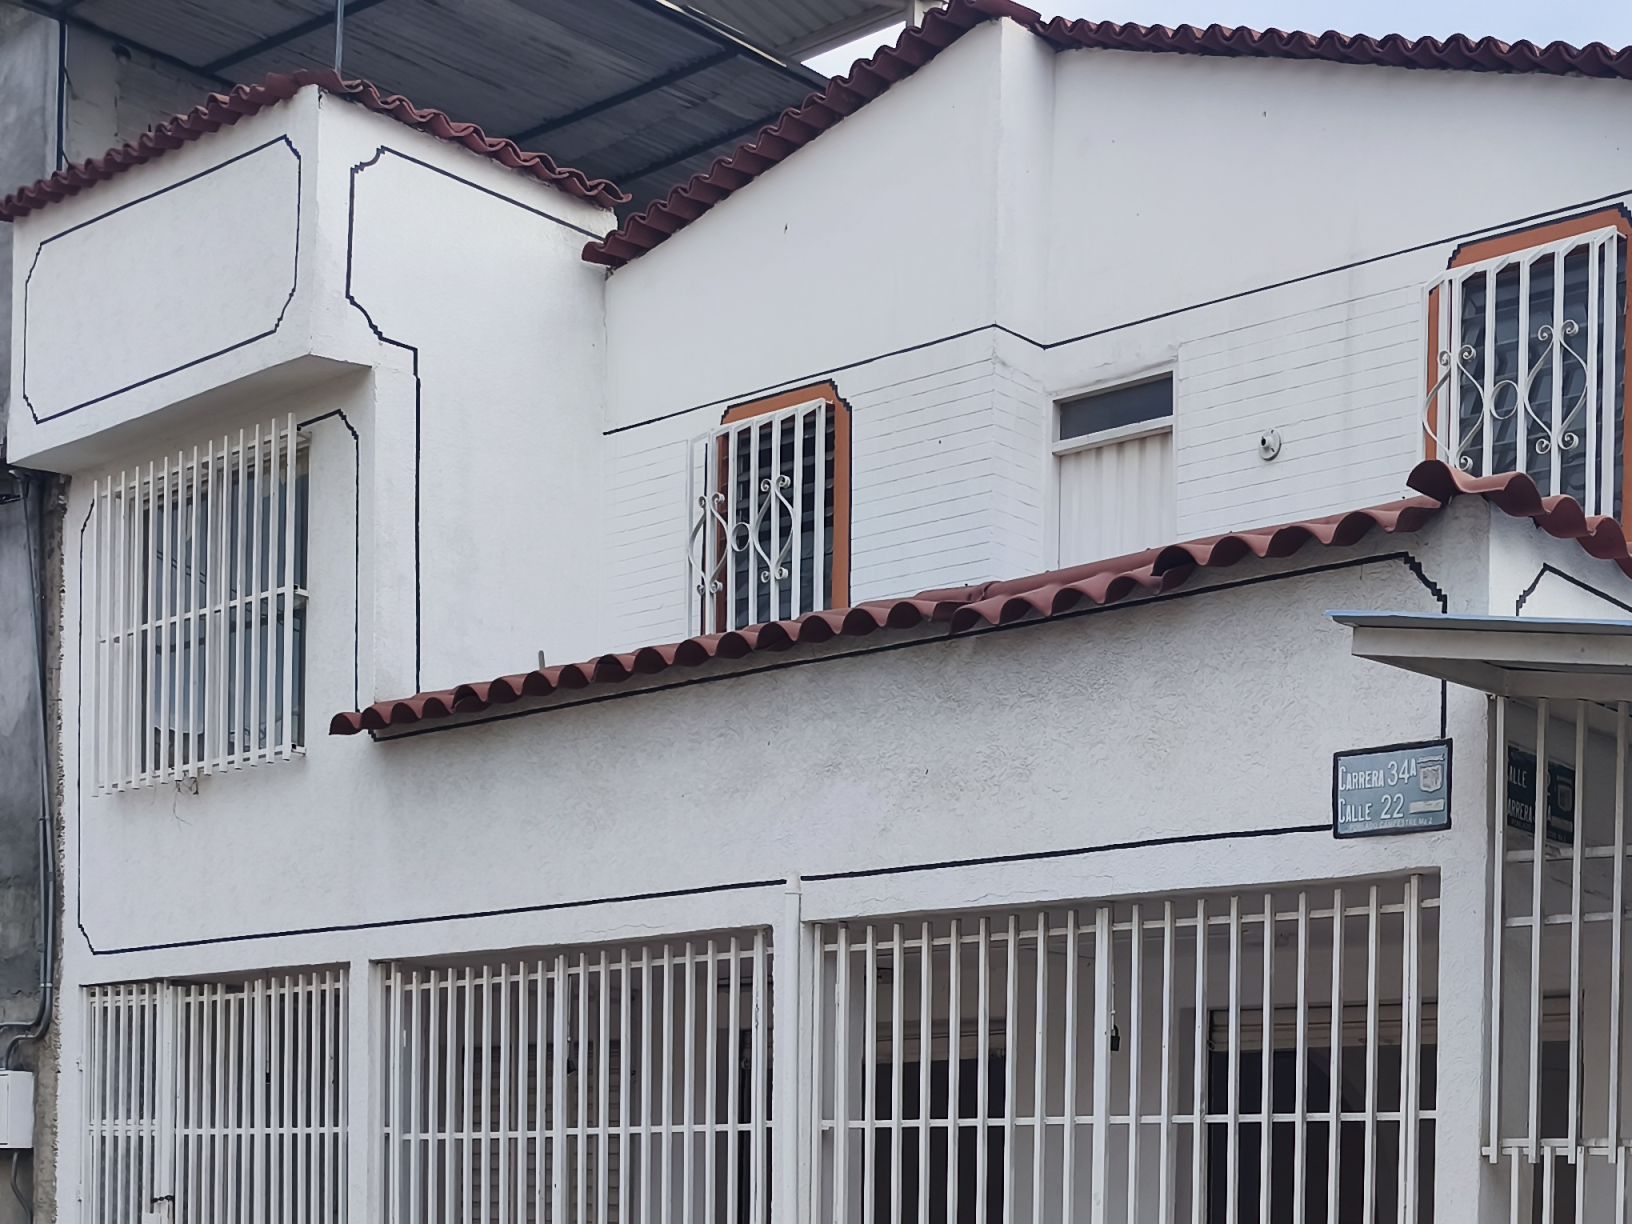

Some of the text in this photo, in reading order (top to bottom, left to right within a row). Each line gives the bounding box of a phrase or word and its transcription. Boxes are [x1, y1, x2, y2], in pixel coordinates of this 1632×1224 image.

[1339, 758, 1417, 791] CARRERA 34A
[1508, 765, 1527, 789] ALLE
[1339, 793, 1404, 823] CALLE 22
[1507, 798, 1533, 824] ARRERA
